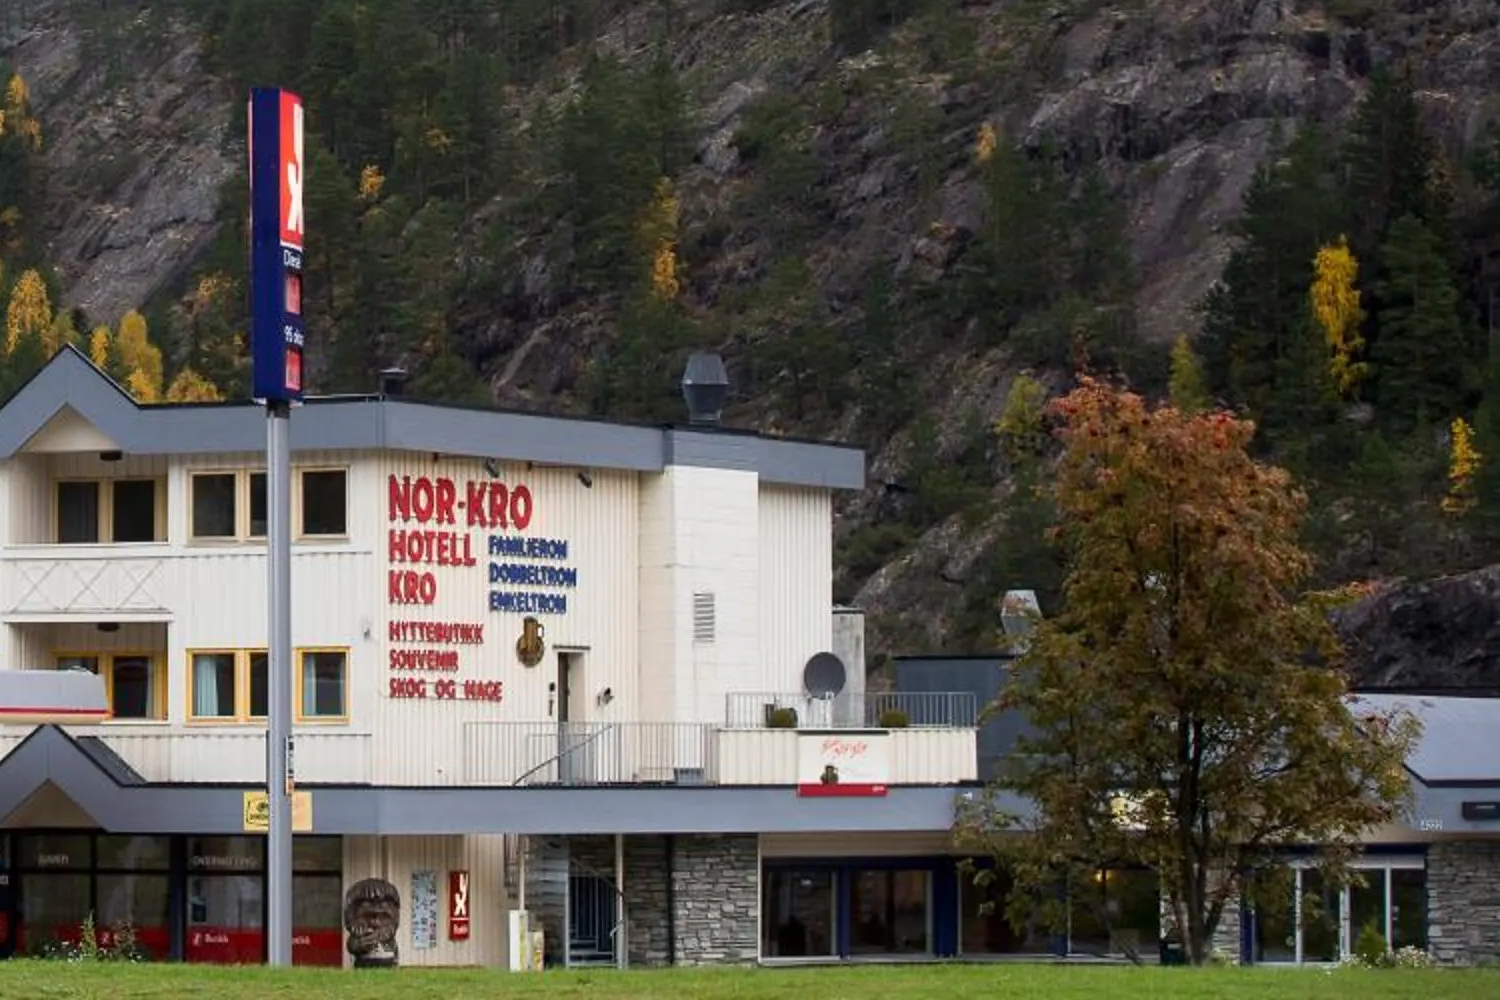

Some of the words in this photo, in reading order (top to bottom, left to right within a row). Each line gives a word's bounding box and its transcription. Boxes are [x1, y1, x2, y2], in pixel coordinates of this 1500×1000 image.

[388, 474, 533, 530] NOR-KRO
[388, 529, 477, 567] HOTELL
[388, 570, 437, 604] KRO
[388, 620, 485, 645] HYTTEBUTIKK
[388, 649, 459, 672] SOUVENIR
[388, 677, 427, 698] SKOG
[435, 679, 456, 699] OG
